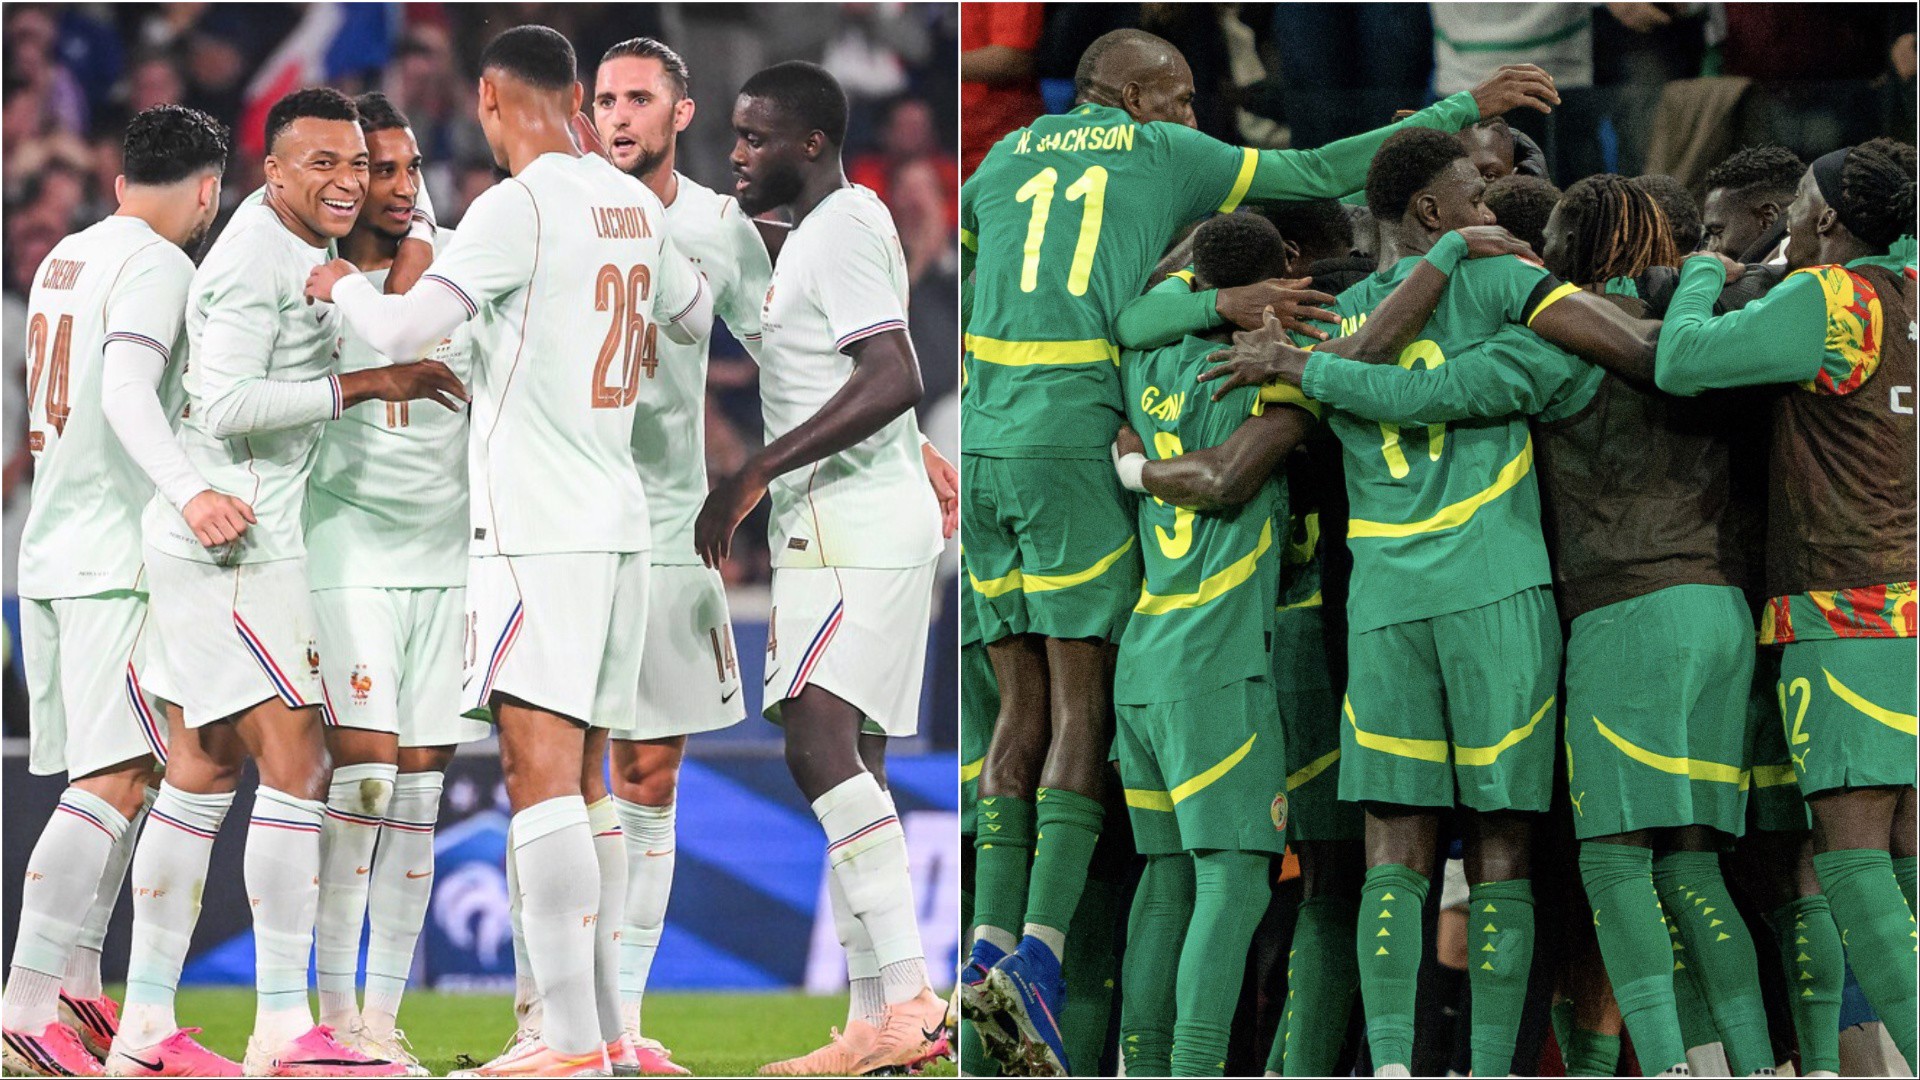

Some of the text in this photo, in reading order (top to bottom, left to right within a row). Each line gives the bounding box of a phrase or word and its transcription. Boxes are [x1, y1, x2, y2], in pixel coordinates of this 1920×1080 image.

[1014, 124, 1135, 154] N. JACKSON
[591, 206, 652, 239] LACROIX
[1015, 165, 1109, 296] 11
[42, 258, 86, 290] CHERKI
[591, 263, 650, 409] 26
[641, 321, 659, 379] 4
[28, 312, 73, 439] 24
[710, 626, 736, 683] 14
